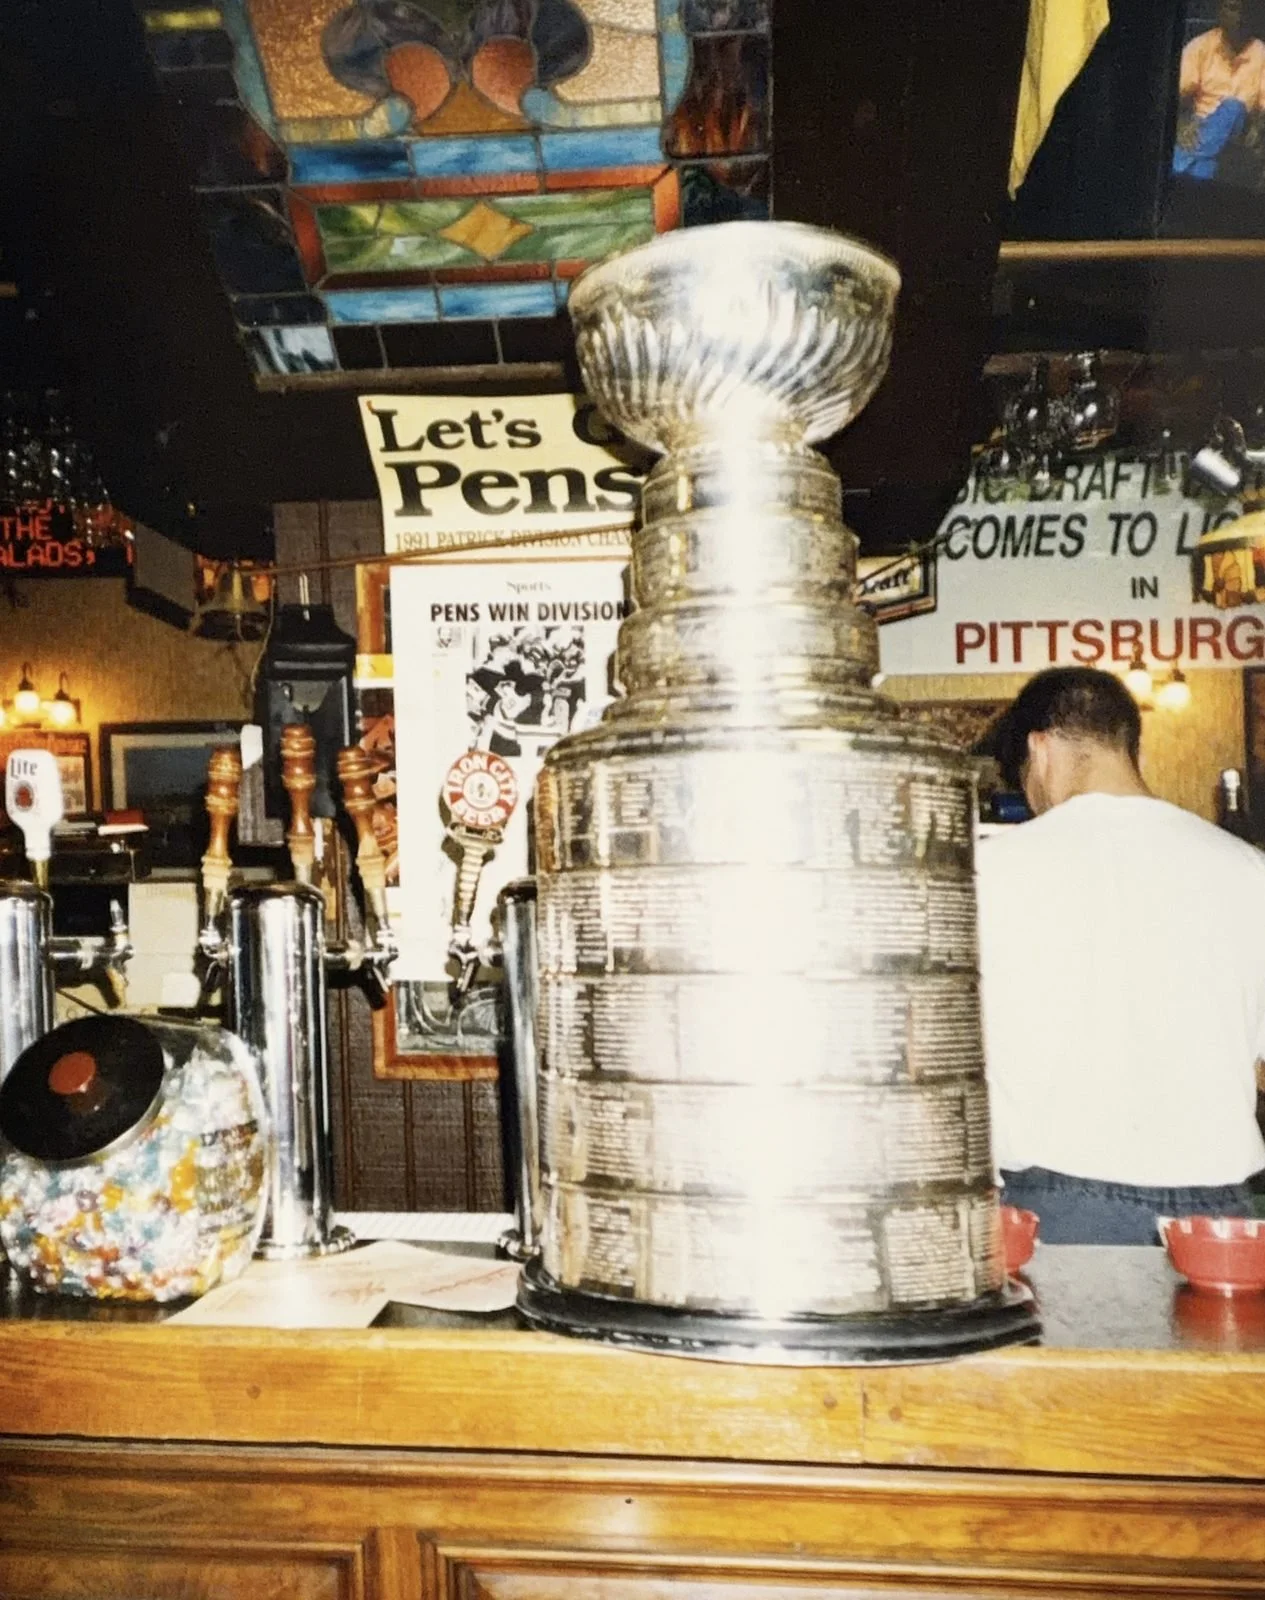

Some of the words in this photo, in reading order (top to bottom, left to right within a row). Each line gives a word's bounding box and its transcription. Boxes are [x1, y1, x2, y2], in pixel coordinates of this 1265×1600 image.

[372, 409, 542, 453] Let's
[384, 460, 643, 518] Pens
[0, 517, 52, 540] THE
[395, 531, 431, 552] 1991
[437, 529, 505, 550] PATRICK
[511, 528, 583, 549] DIVISION
[944, 512, 1088, 560] COMES
[1108, 511, 1158, 556] TO
[1131, 577, 1159, 599] IN
[430, 603, 480, 623] PENS
[488, 602, 530, 622] WIN
[537, 601, 629, 622] DIVISION
[954, 615, 1265, 665] PITTSBURG
[10, 757, 38, 779] Lite
[446, 754, 489, 792] IRON
[489, 760, 516, 806] CITY
[451, 799, 507, 826] BEER
